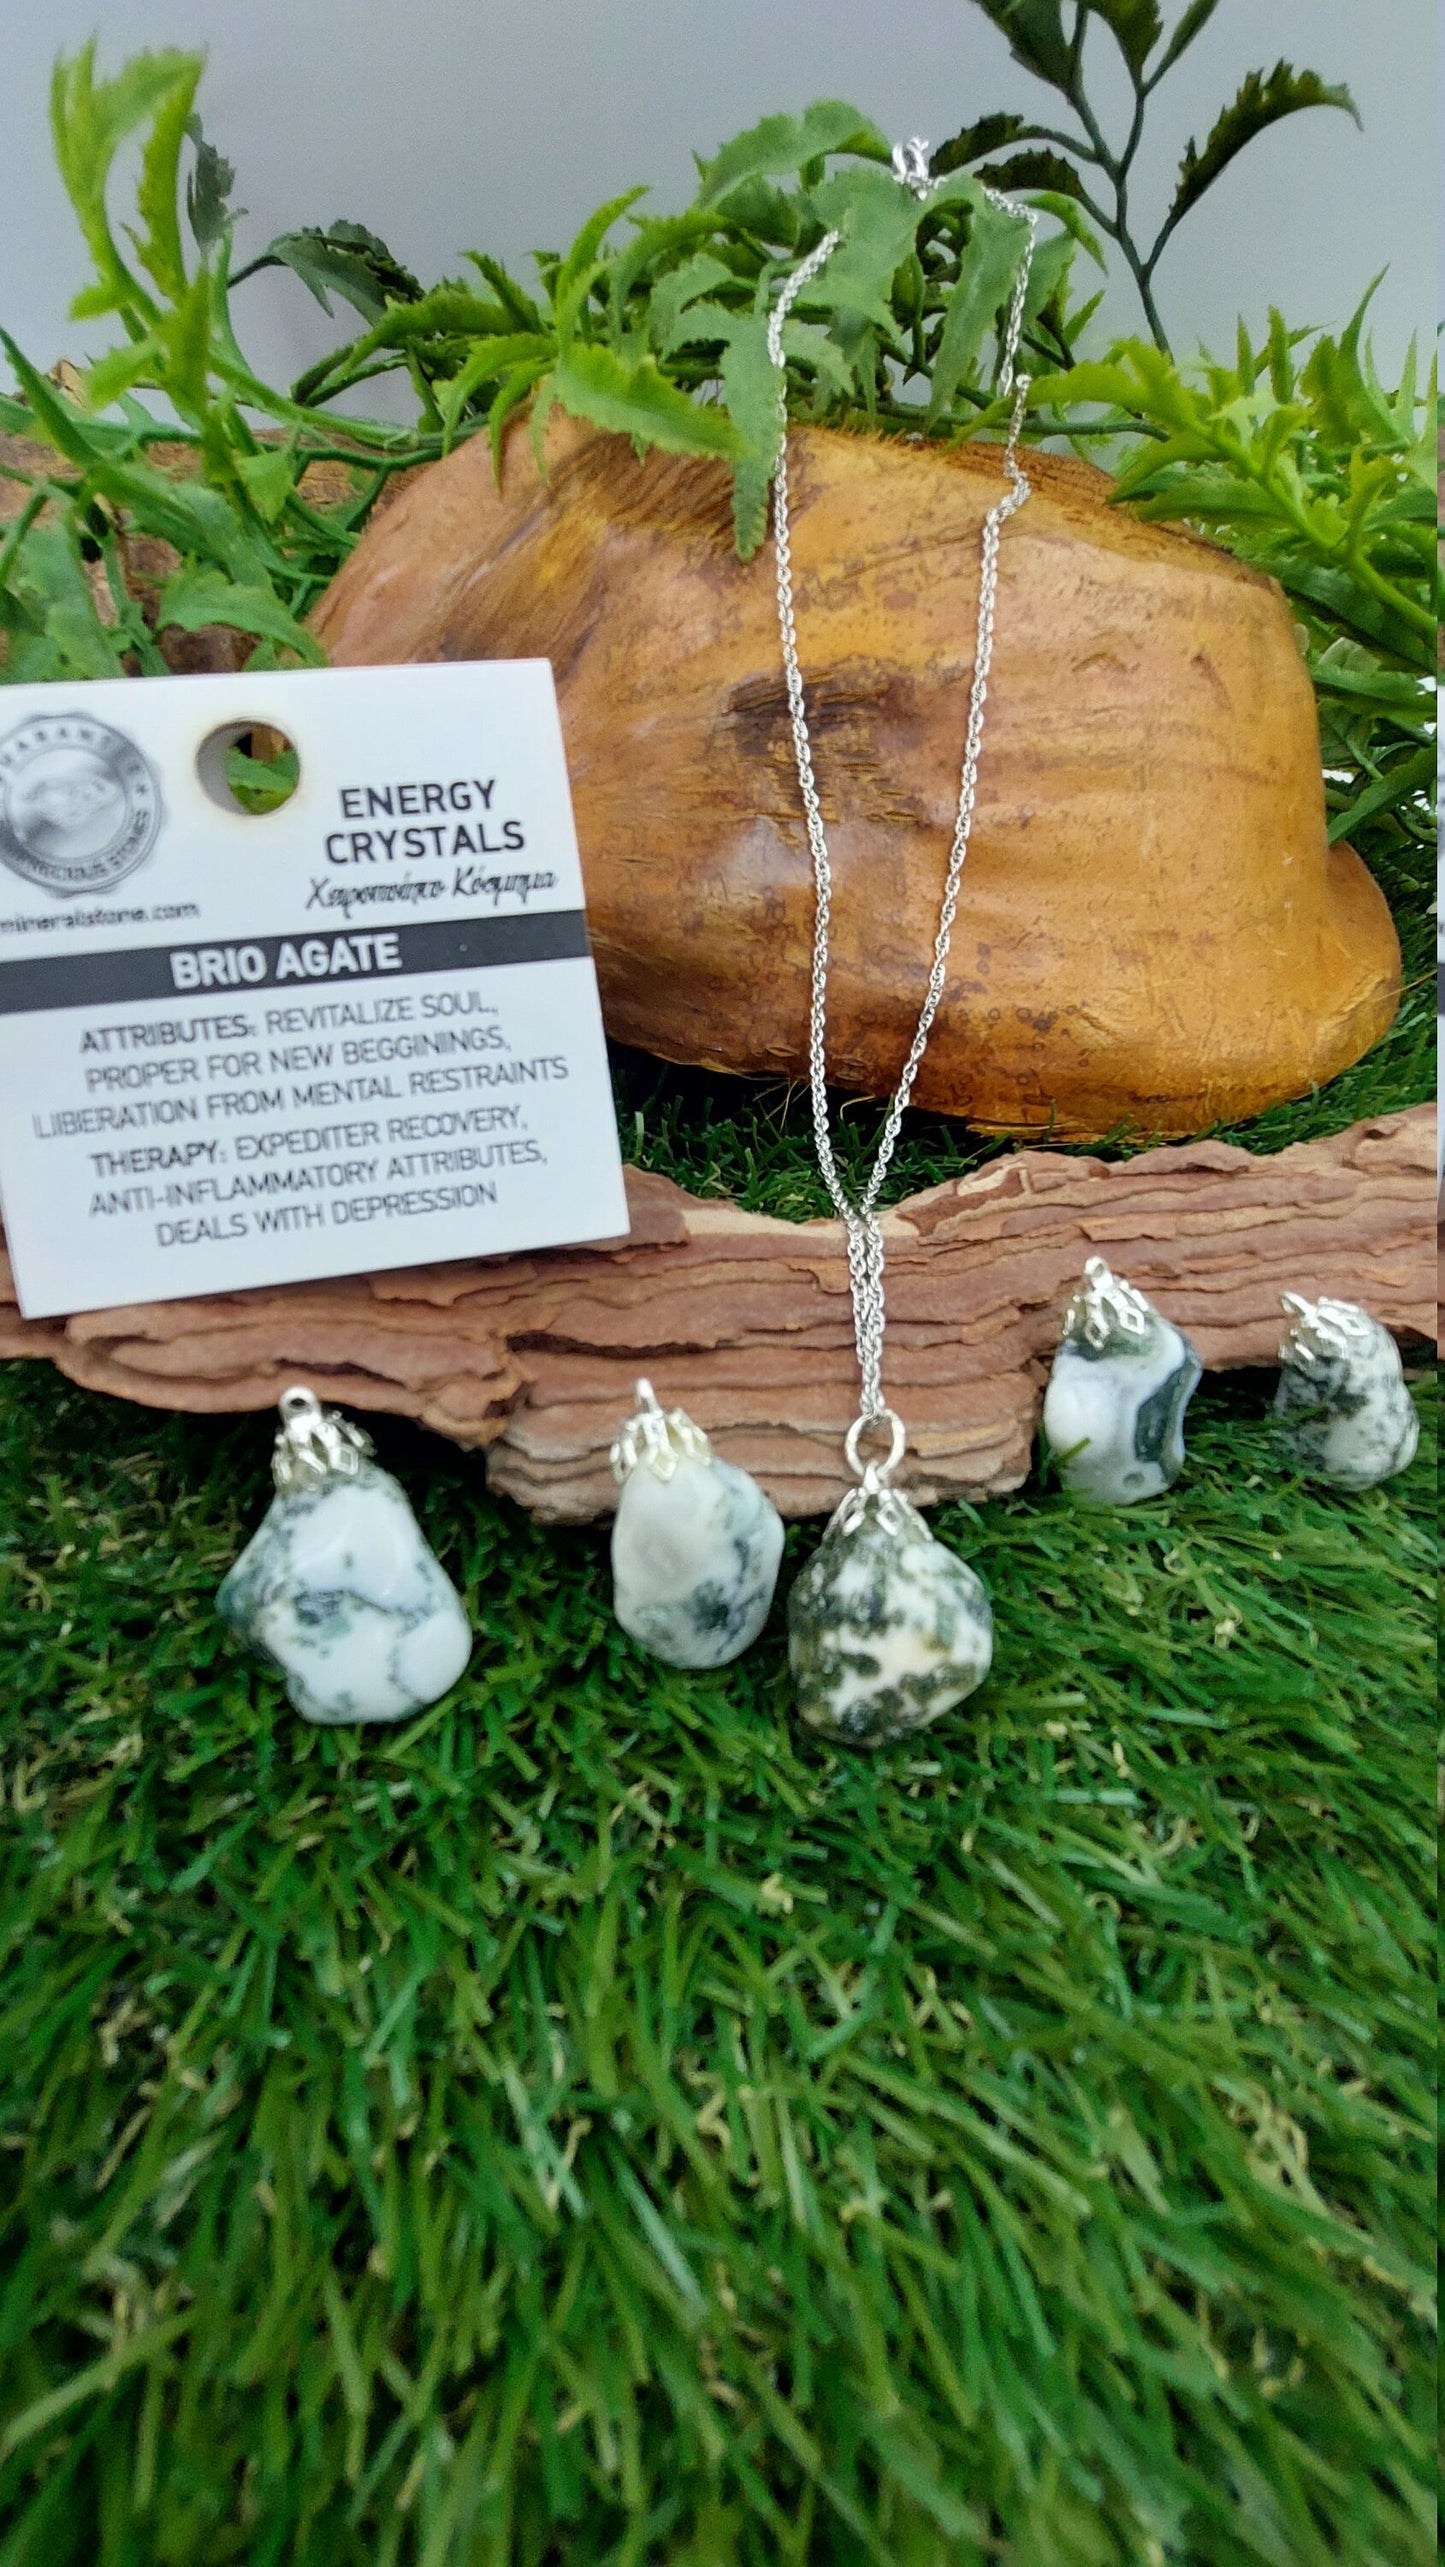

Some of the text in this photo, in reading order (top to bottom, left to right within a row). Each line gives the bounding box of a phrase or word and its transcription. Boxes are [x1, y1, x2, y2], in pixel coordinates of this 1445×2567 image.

[340, 779, 496, 819] ENERGY
[325, 820, 526, 864] CRYSTALS
[169, 933, 403, 991] BRIO AGATE
[264, 995, 415, 1035] REVITALIZE
[84, 1056, 201, 1094] PROPER
[206, 1050, 262, 1080] FOR
[268, 1042, 334, 1074] NEW
[31, 1056, 569, 1139] LIBERATION FROM MENTAL RESTRAINTS
[234, 1121, 380, 1161] EXPEDITER
[88, 1158, 379, 1218] ANTI-INFLAMMATORY
[155, 1180, 499, 1248] DEALS WITH DEPRESSION
